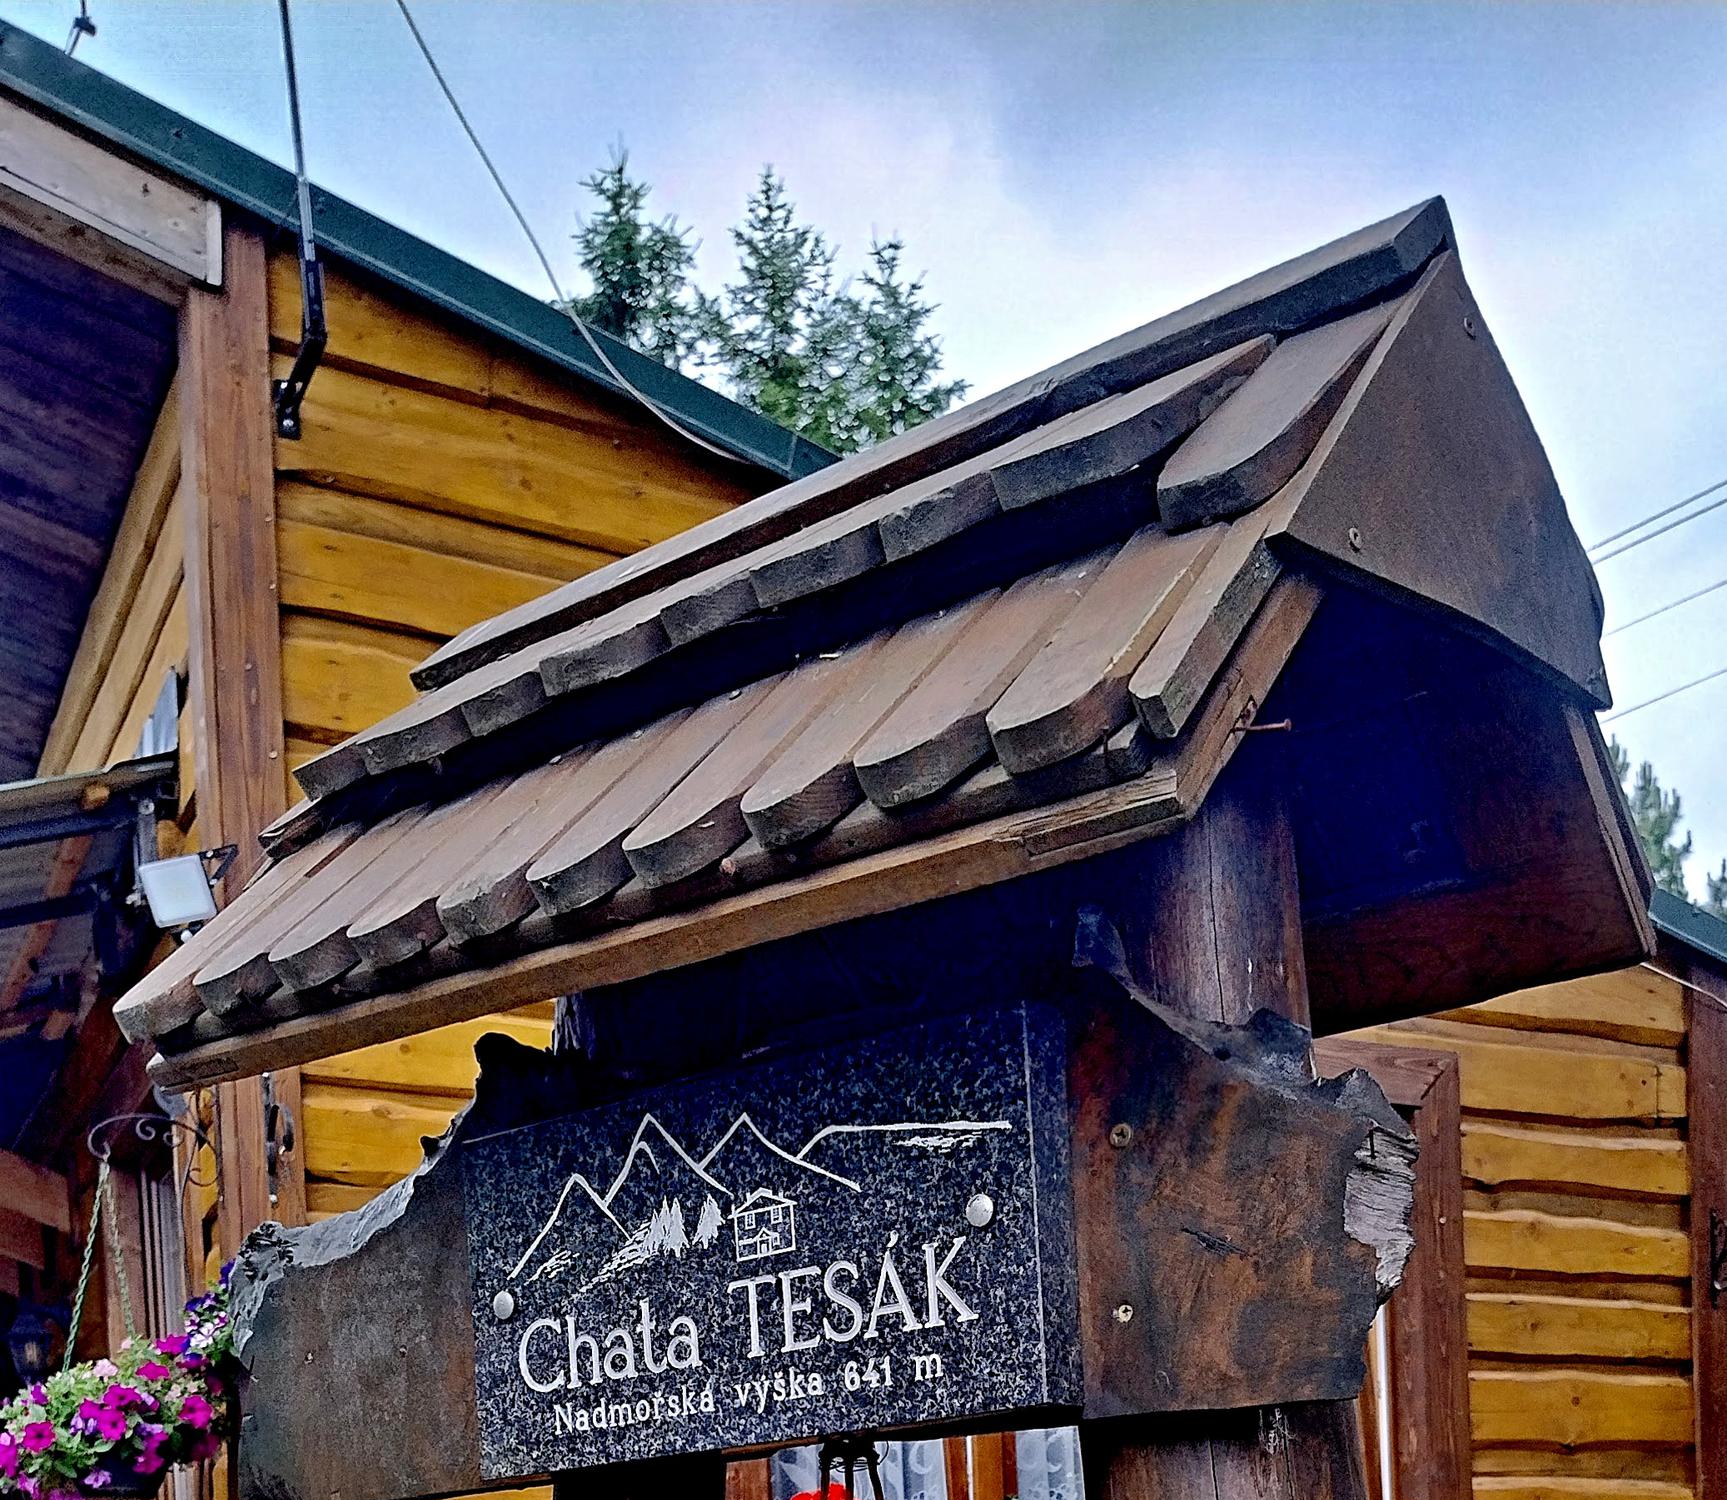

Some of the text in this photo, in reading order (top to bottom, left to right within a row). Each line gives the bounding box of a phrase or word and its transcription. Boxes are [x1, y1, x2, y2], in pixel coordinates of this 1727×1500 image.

[519, 1230, 980, 1393] Chata TESÁK
[553, 1353, 944, 1435] Nadmořská výška 641 m
